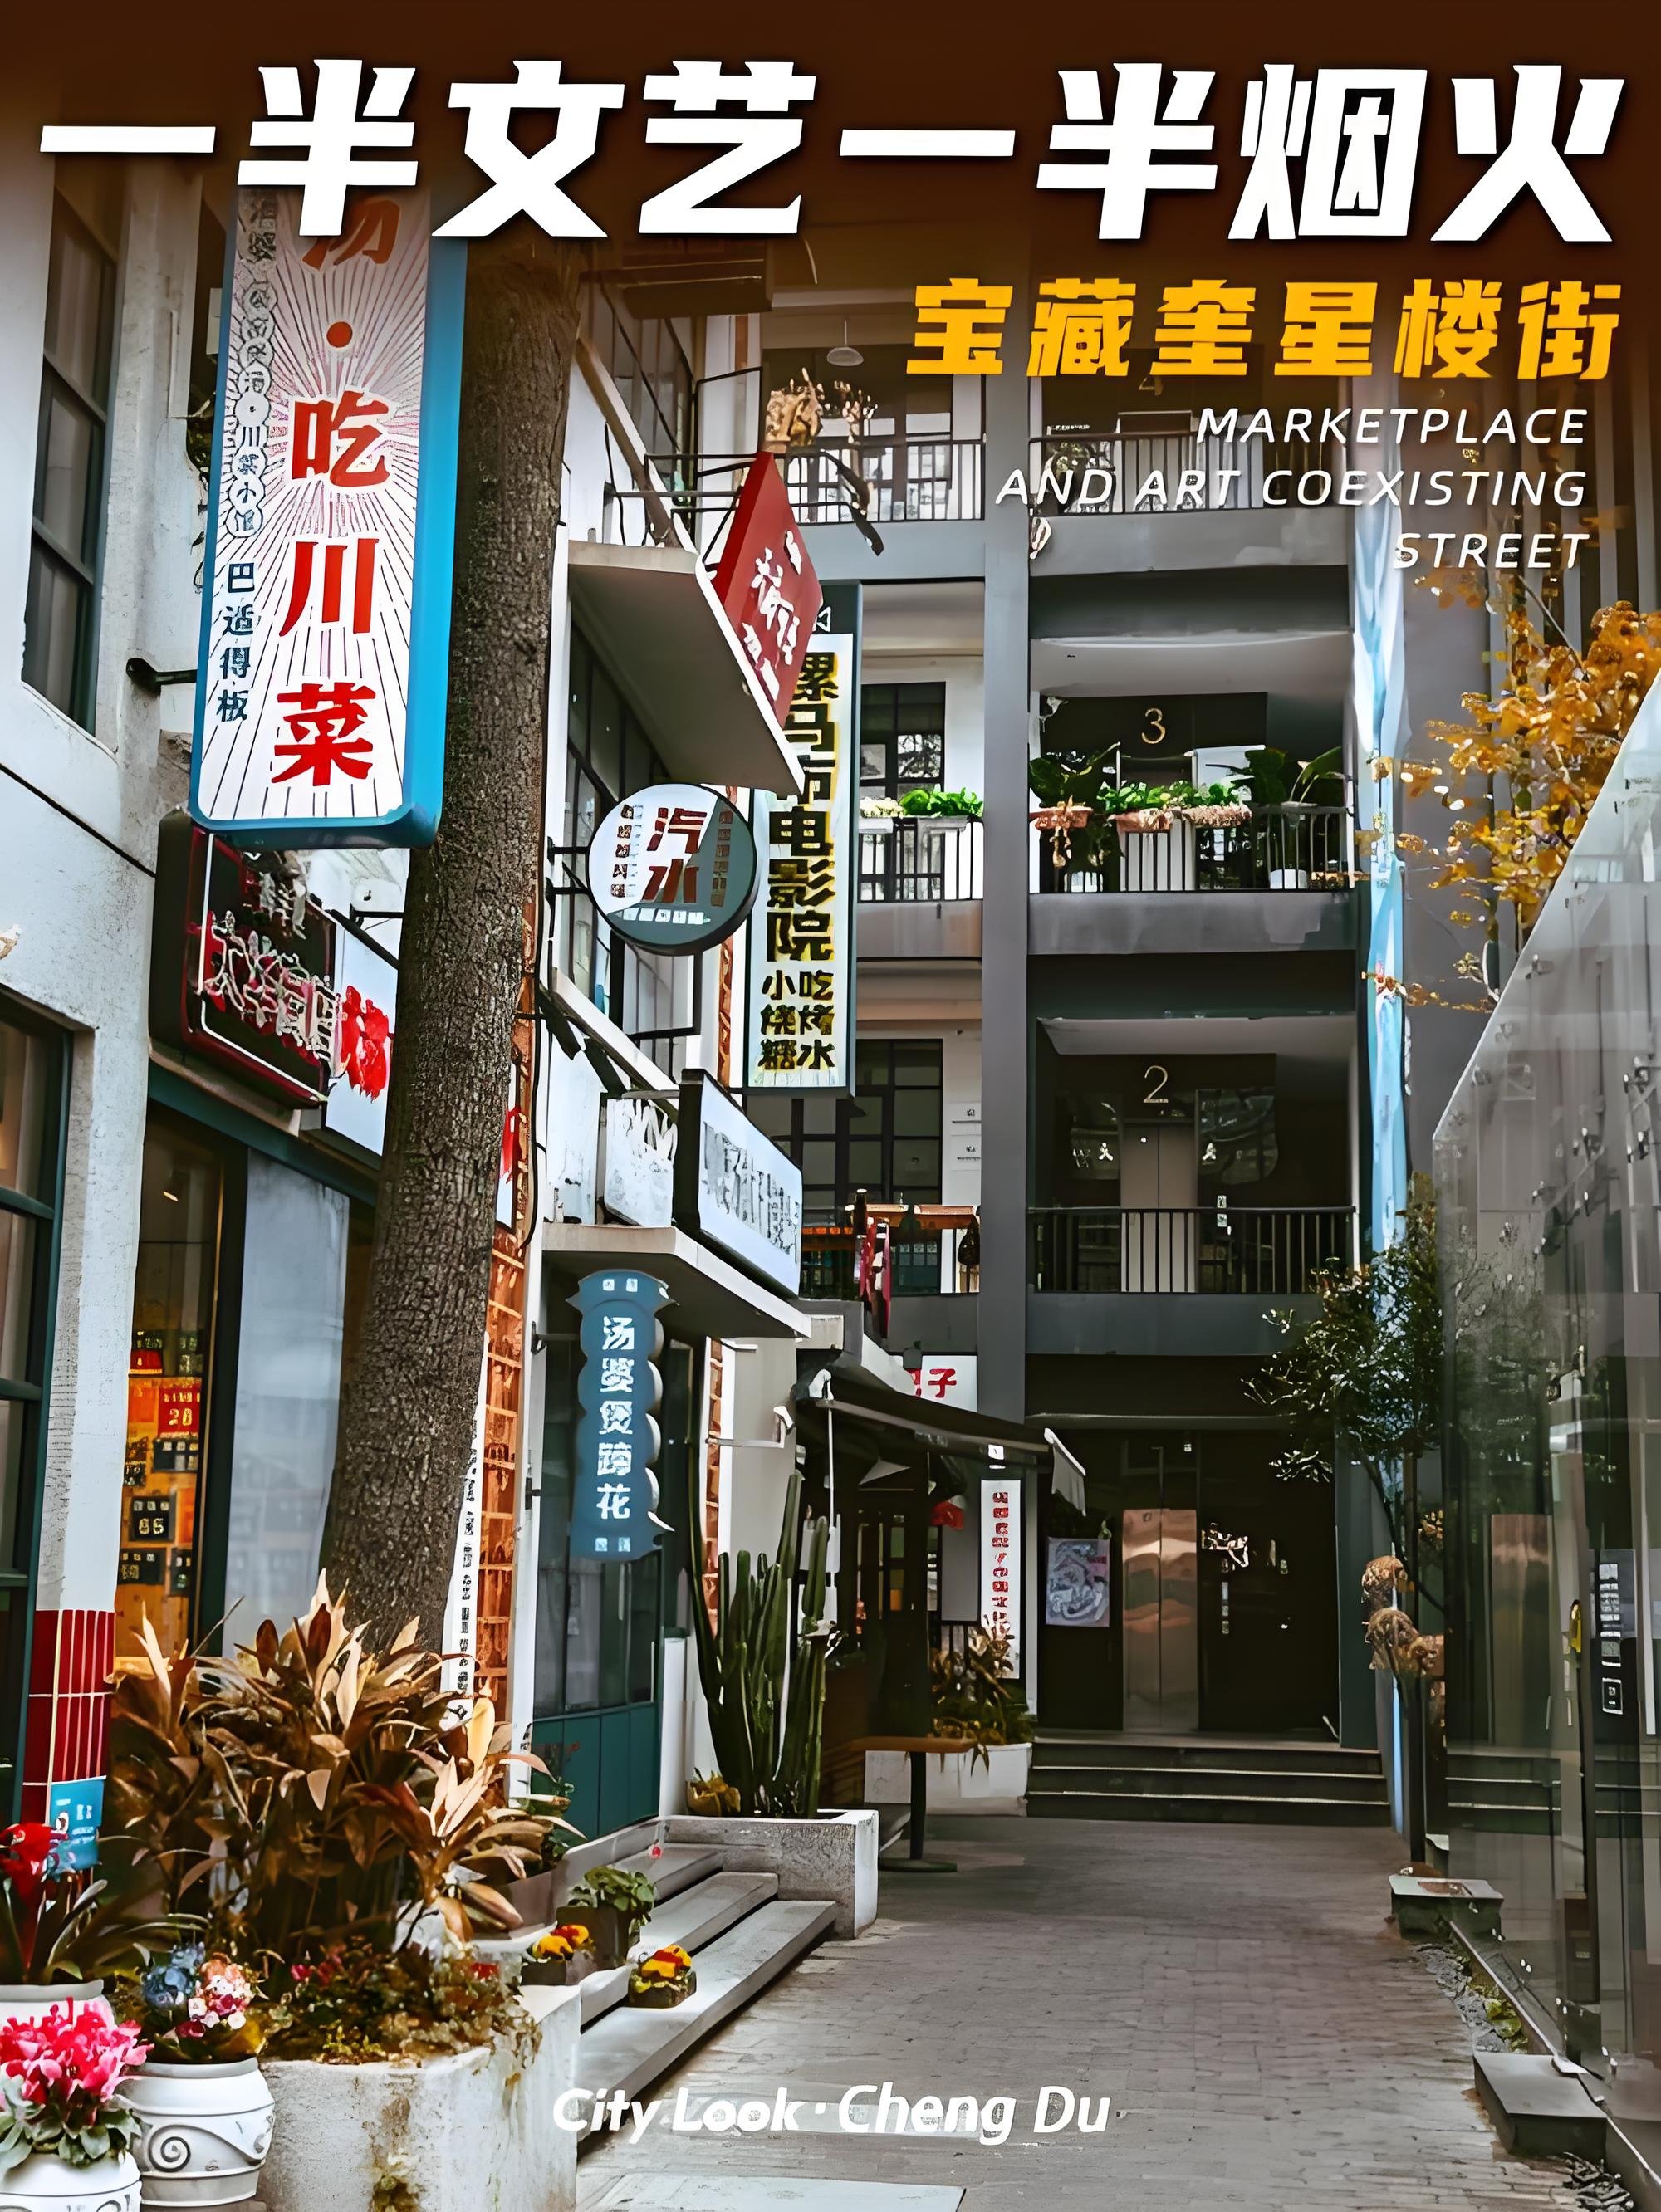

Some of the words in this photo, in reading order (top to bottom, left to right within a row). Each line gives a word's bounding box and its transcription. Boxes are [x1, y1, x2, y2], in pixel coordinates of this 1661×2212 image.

[1141, 708, 1166, 744] 3
[641, 807, 708, 904] 汽水
[762, 970, 834, 1001] 小吃
[1144, 1065, 1169, 1104] 2
